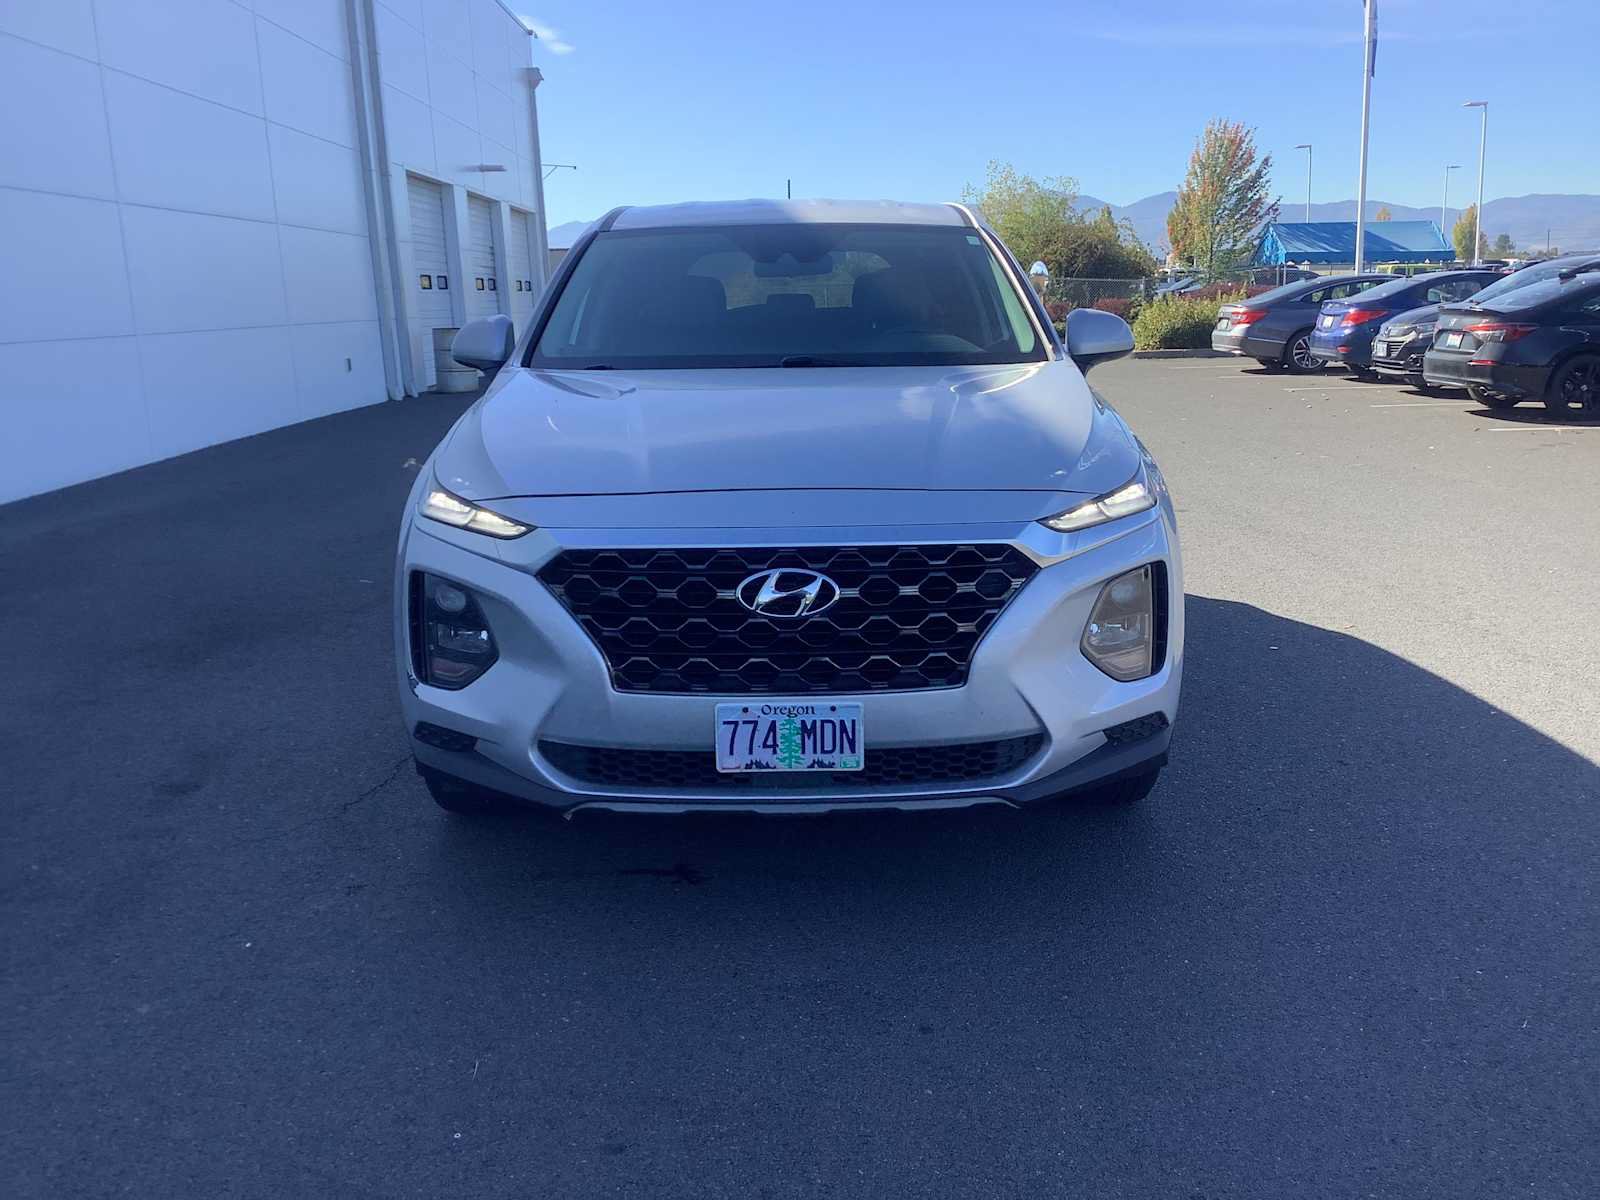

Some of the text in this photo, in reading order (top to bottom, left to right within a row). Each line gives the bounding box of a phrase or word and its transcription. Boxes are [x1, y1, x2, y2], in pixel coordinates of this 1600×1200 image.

[761, 704, 816, 719] Oregon
[722, 719, 857, 756] 774 MDN
